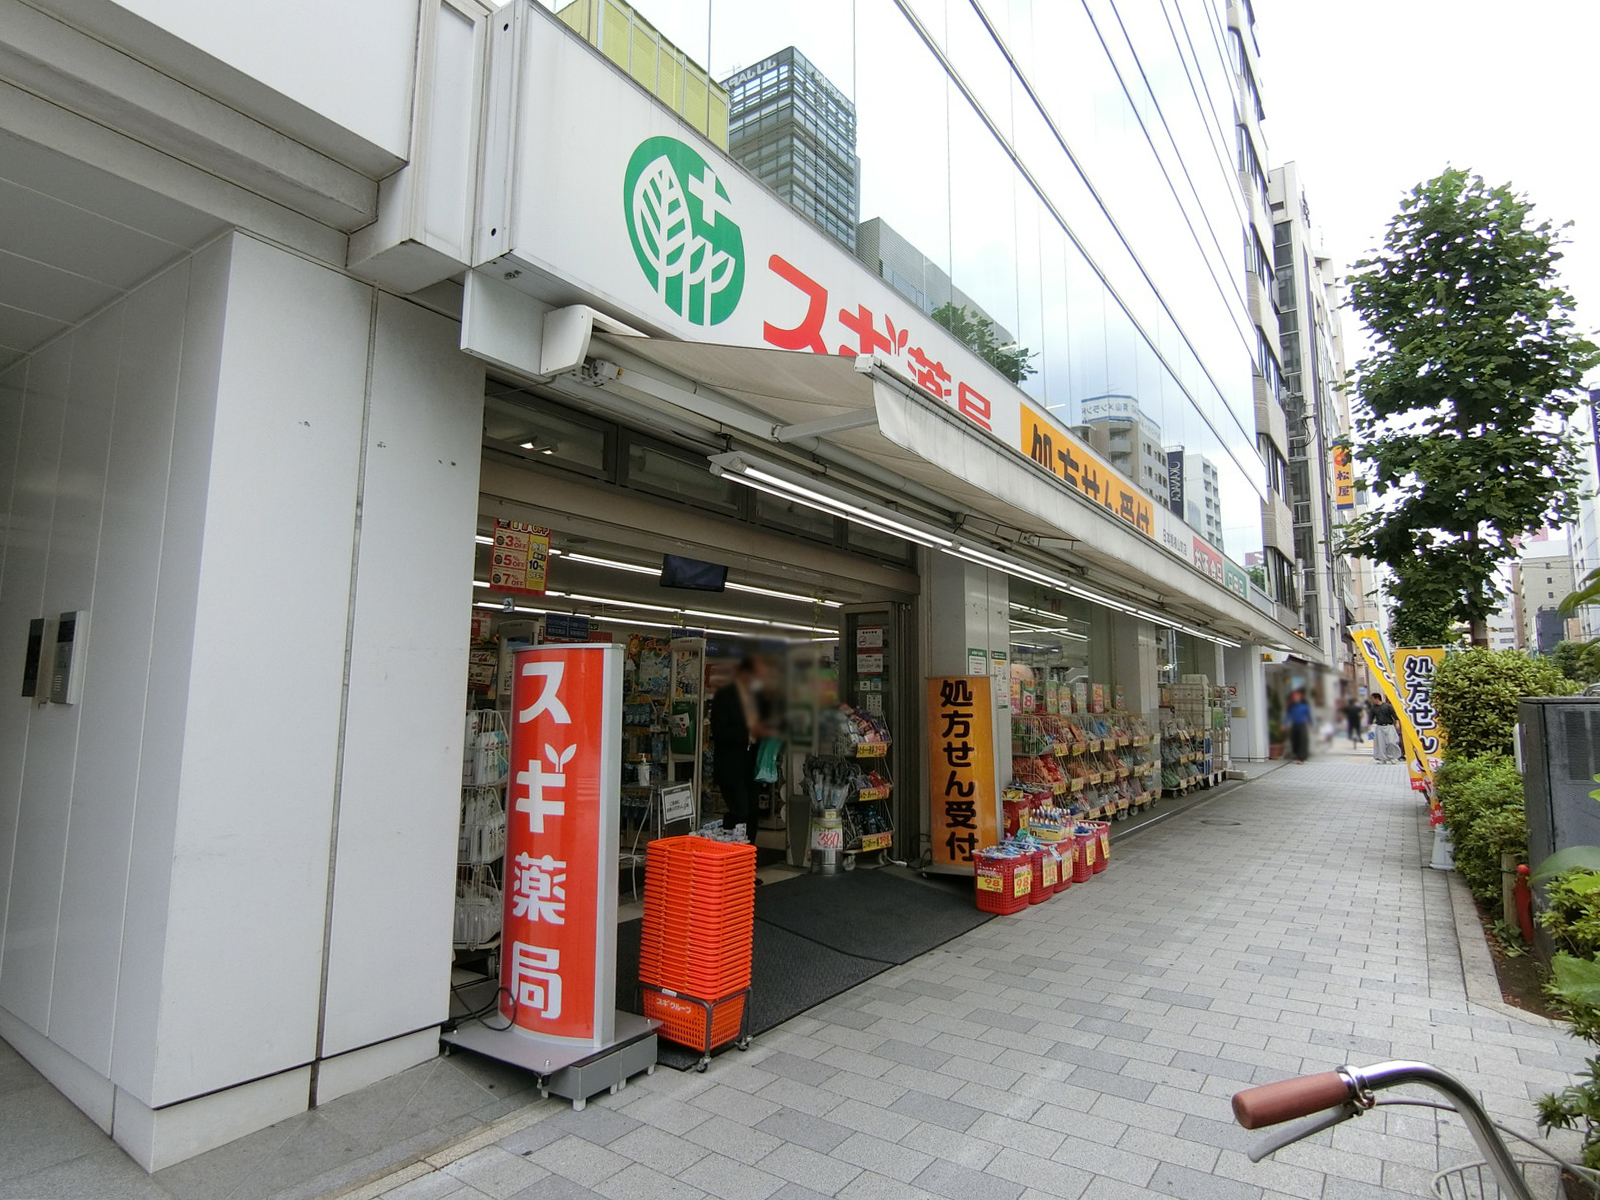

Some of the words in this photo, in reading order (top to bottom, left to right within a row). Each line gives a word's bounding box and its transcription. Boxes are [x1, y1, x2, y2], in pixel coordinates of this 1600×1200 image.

[1336, 470, 1350, 497] 松屋
[939, 679, 980, 863] 処方せん受付
[510, 660, 576, 1019] スギ薬局
[817, 832, 841, 847] 380
[984, 878, 1001, 887] 98
[1016, 876, 1029, 891] 98
